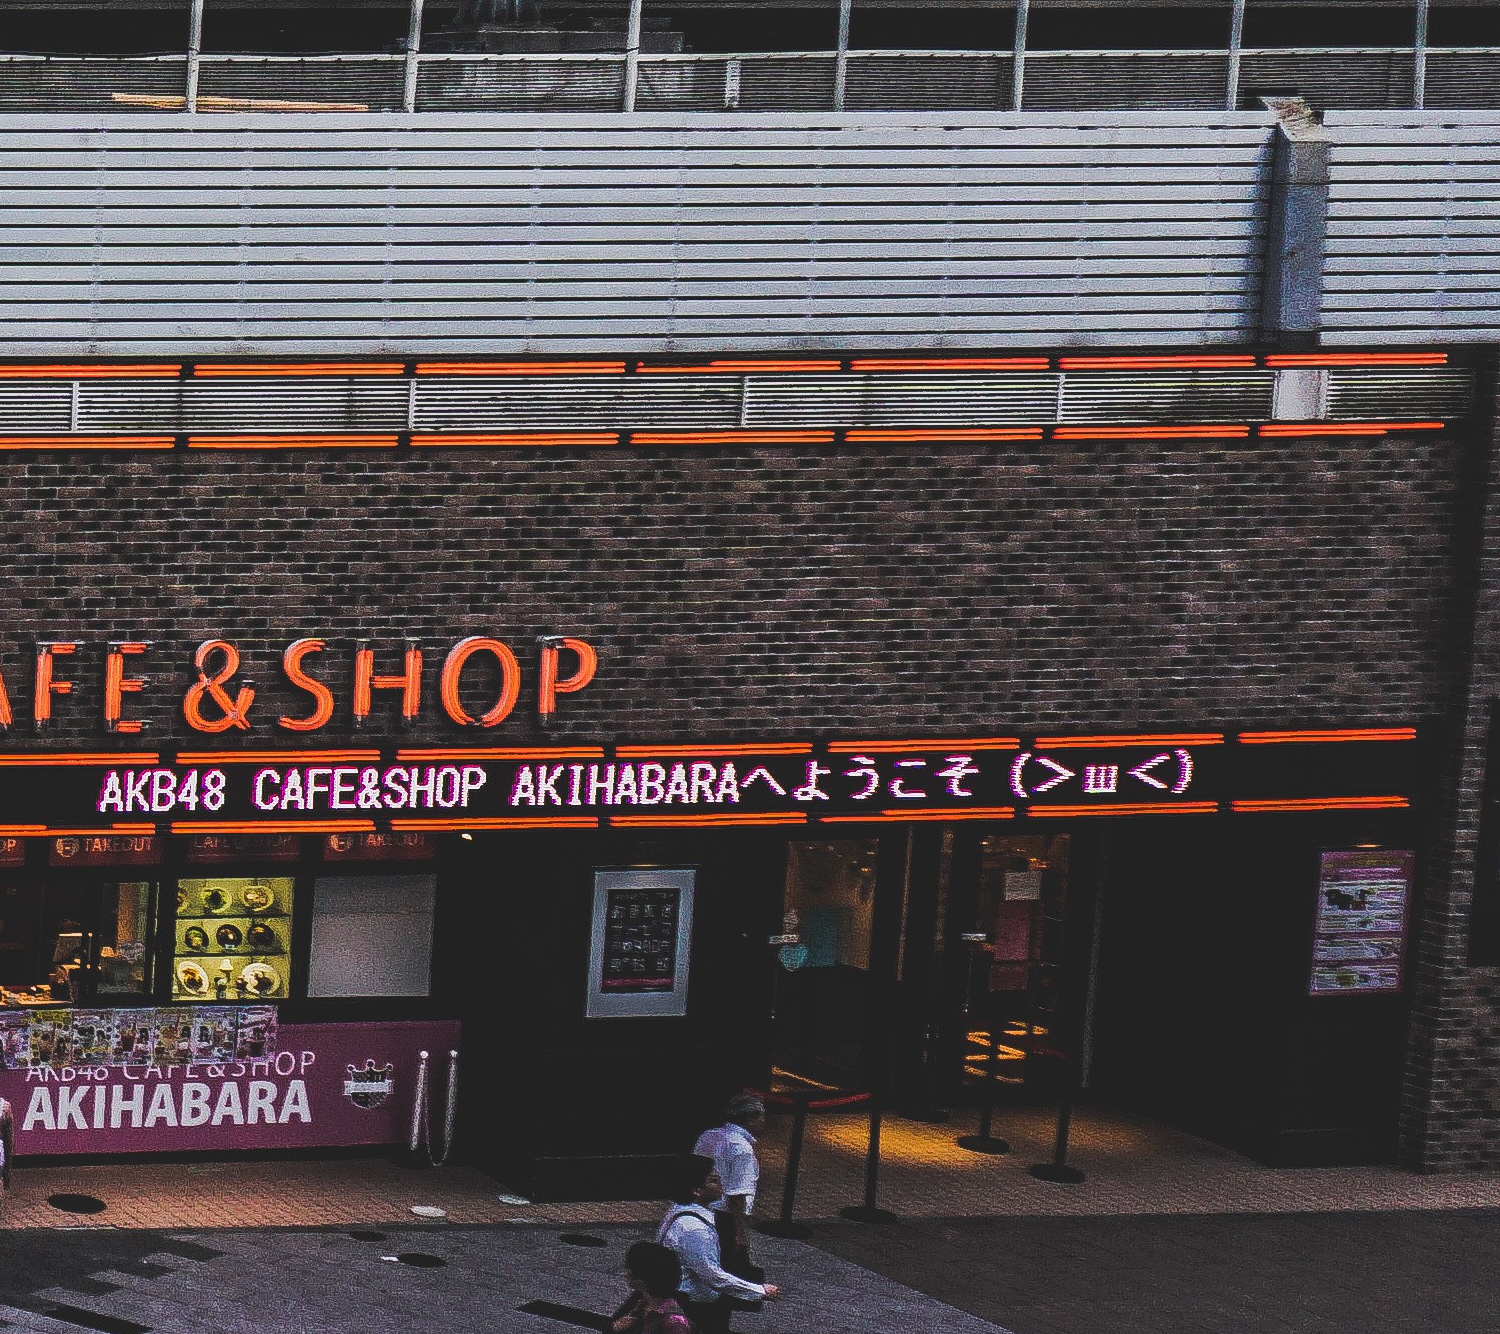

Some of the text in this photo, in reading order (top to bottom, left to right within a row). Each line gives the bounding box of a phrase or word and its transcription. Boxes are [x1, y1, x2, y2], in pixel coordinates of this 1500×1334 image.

[97, 769, 227, 813] AKB48
[252, 765, 487, 811] CAFE&SHOP
[21, 1079, 313, 1132] AKIHABARA
